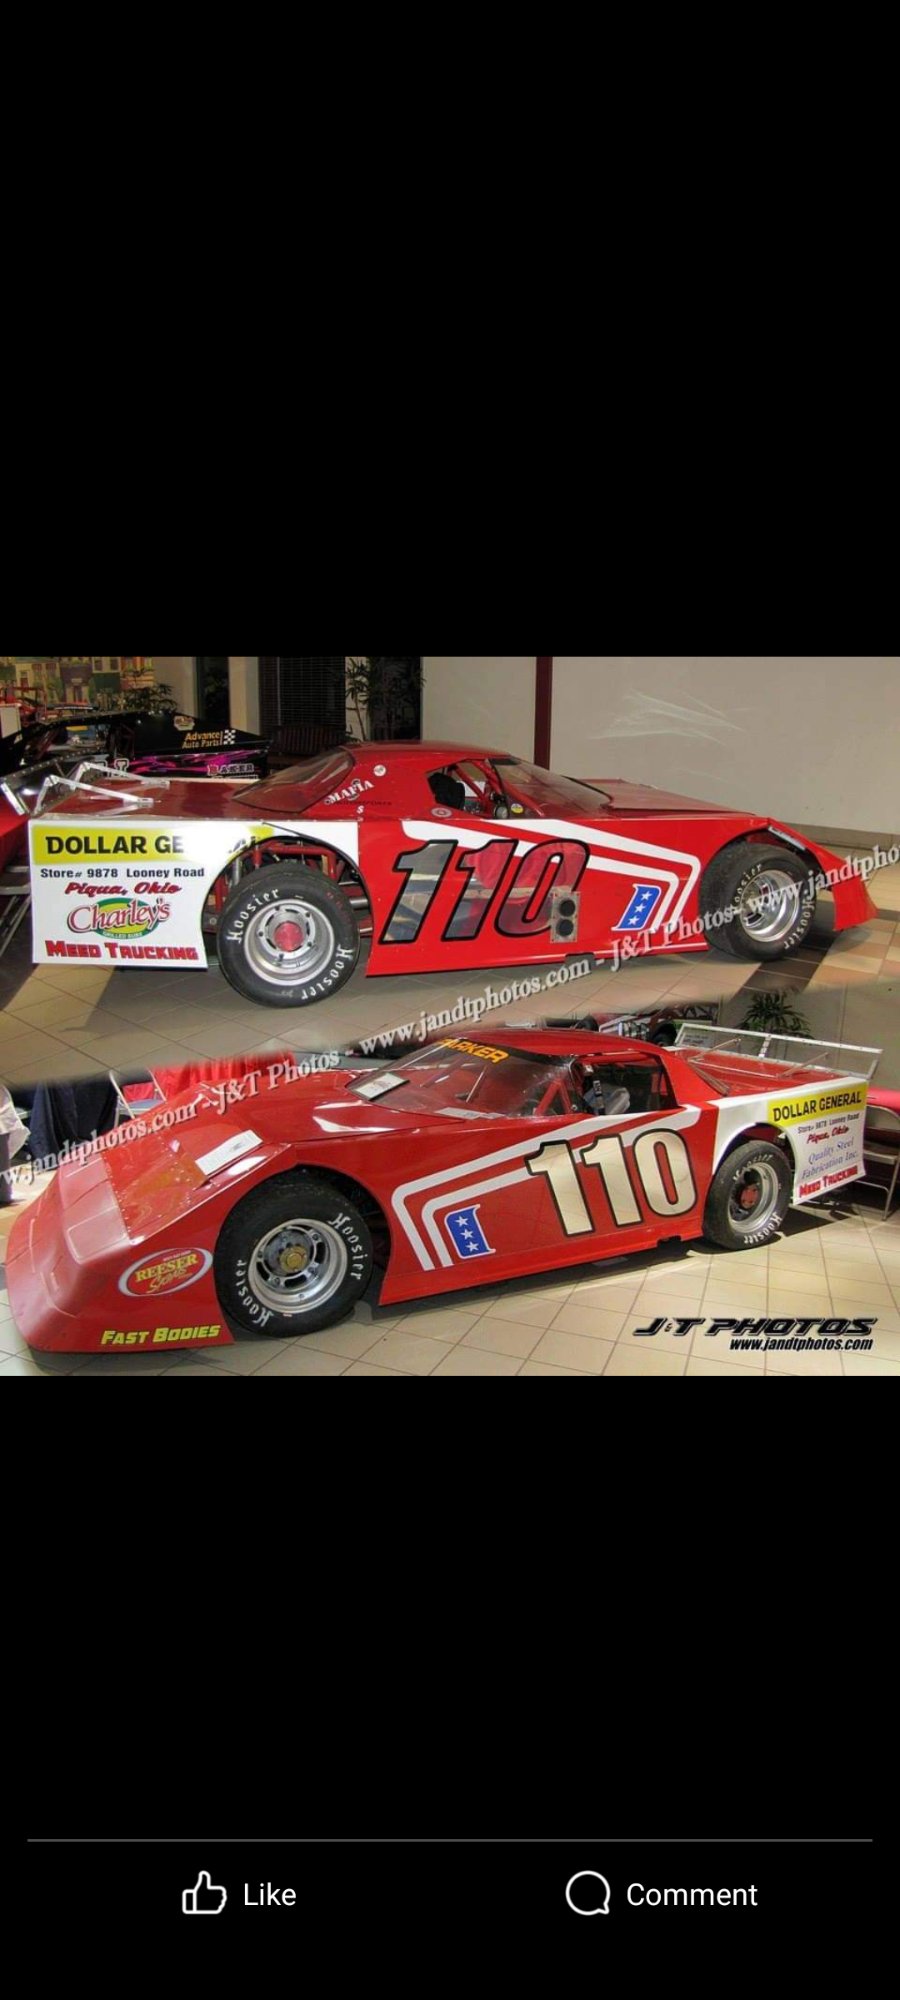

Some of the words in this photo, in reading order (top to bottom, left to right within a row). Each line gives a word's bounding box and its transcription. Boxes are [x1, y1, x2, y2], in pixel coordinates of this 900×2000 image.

[182, 741, 200, 749] Auto
[201, 739, 220, 748] Parts
[184, 731, 220, 740] Advance
[327, 780, 375, 804] MAFIA
[45, 836, 147, 854] DOLLAR
[40, 868, 82, 878] Store#
[87, 868, 118, 878] 9878
[126, 867, 170, 879] Looney
[174, 867, 205, 878] Road
[64, 881, 128, 897] Piqua,
[133, 881, 183, 895] Ohio
[378, 838, 590, 945] 110
[67, 897, 171, 933] Charley's
[226, 888, 279, 944] Hoosier
[104, 942, 199, 960] TRUCKING
[301, 944, 354, 999] Hoosier
[773, 1100, 817, 1122] DOLLAR
[819, 1091, 862, 1111] GENERAL
[524, 1128, 698, 1237] 110
[744, 1211, 782, 1244] Hoosier
[328, 1212, 368, 1281] Hoosier
[135, 1253, 198, 1283] REESER
[236, 1259, 275, 1327] Hoosier
[101, 1330, 150, 1345] FAST
[152, 1325, 221, 1343] BODIES
